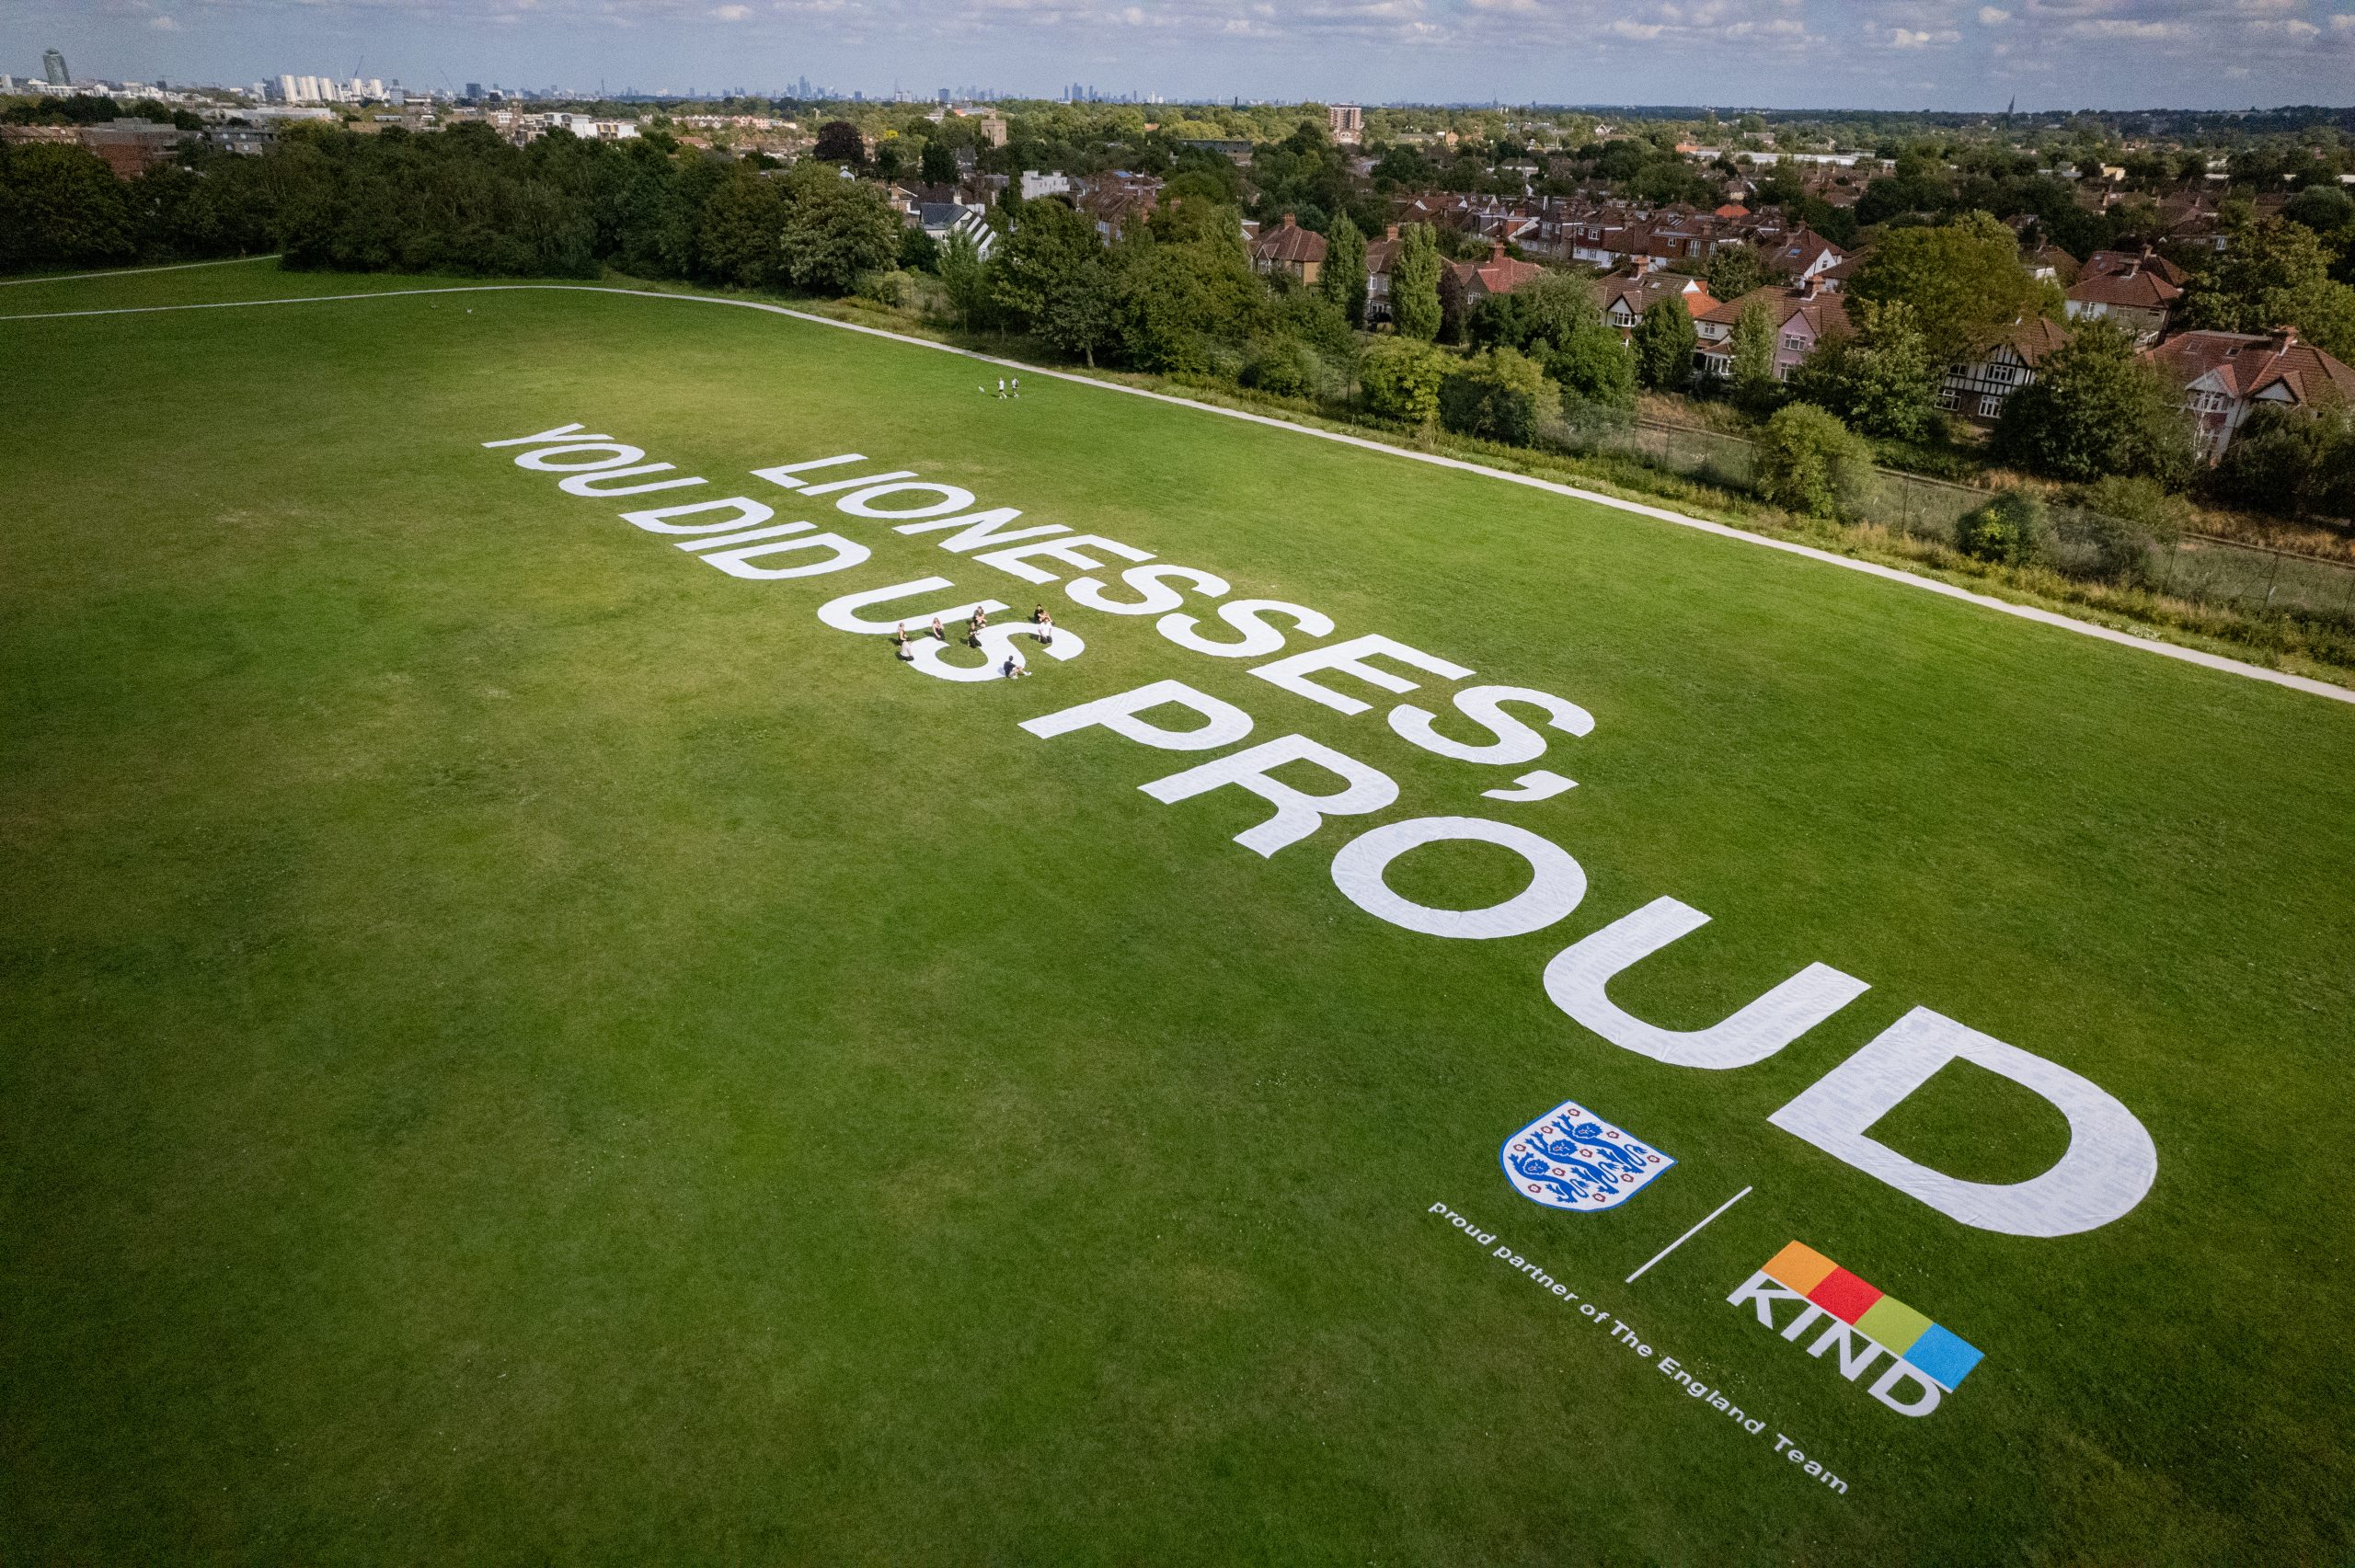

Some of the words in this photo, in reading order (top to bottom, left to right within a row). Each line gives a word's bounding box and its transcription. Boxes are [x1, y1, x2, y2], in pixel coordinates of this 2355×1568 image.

[750, 452, 1596, 803] LIONESSES,
[481, 422, 709, 498] YOU
[617, 496, 872, 580] DID
[817, 576, 1086, 683] US
[1017, 679, 2158, 1238] PROUD
[1428, 1201, 1498, 1246] proud
[1492, 1245, 1580, 1302] partner
[1580, 1303, 1610, 1324] of
[1610, 1319, 1653, 1358] The
[1657, 1356, 1766, 1435] England
[1774, 1433, 1848, 1495] Team
[1726, 1270, 1943, 1417] KIND
